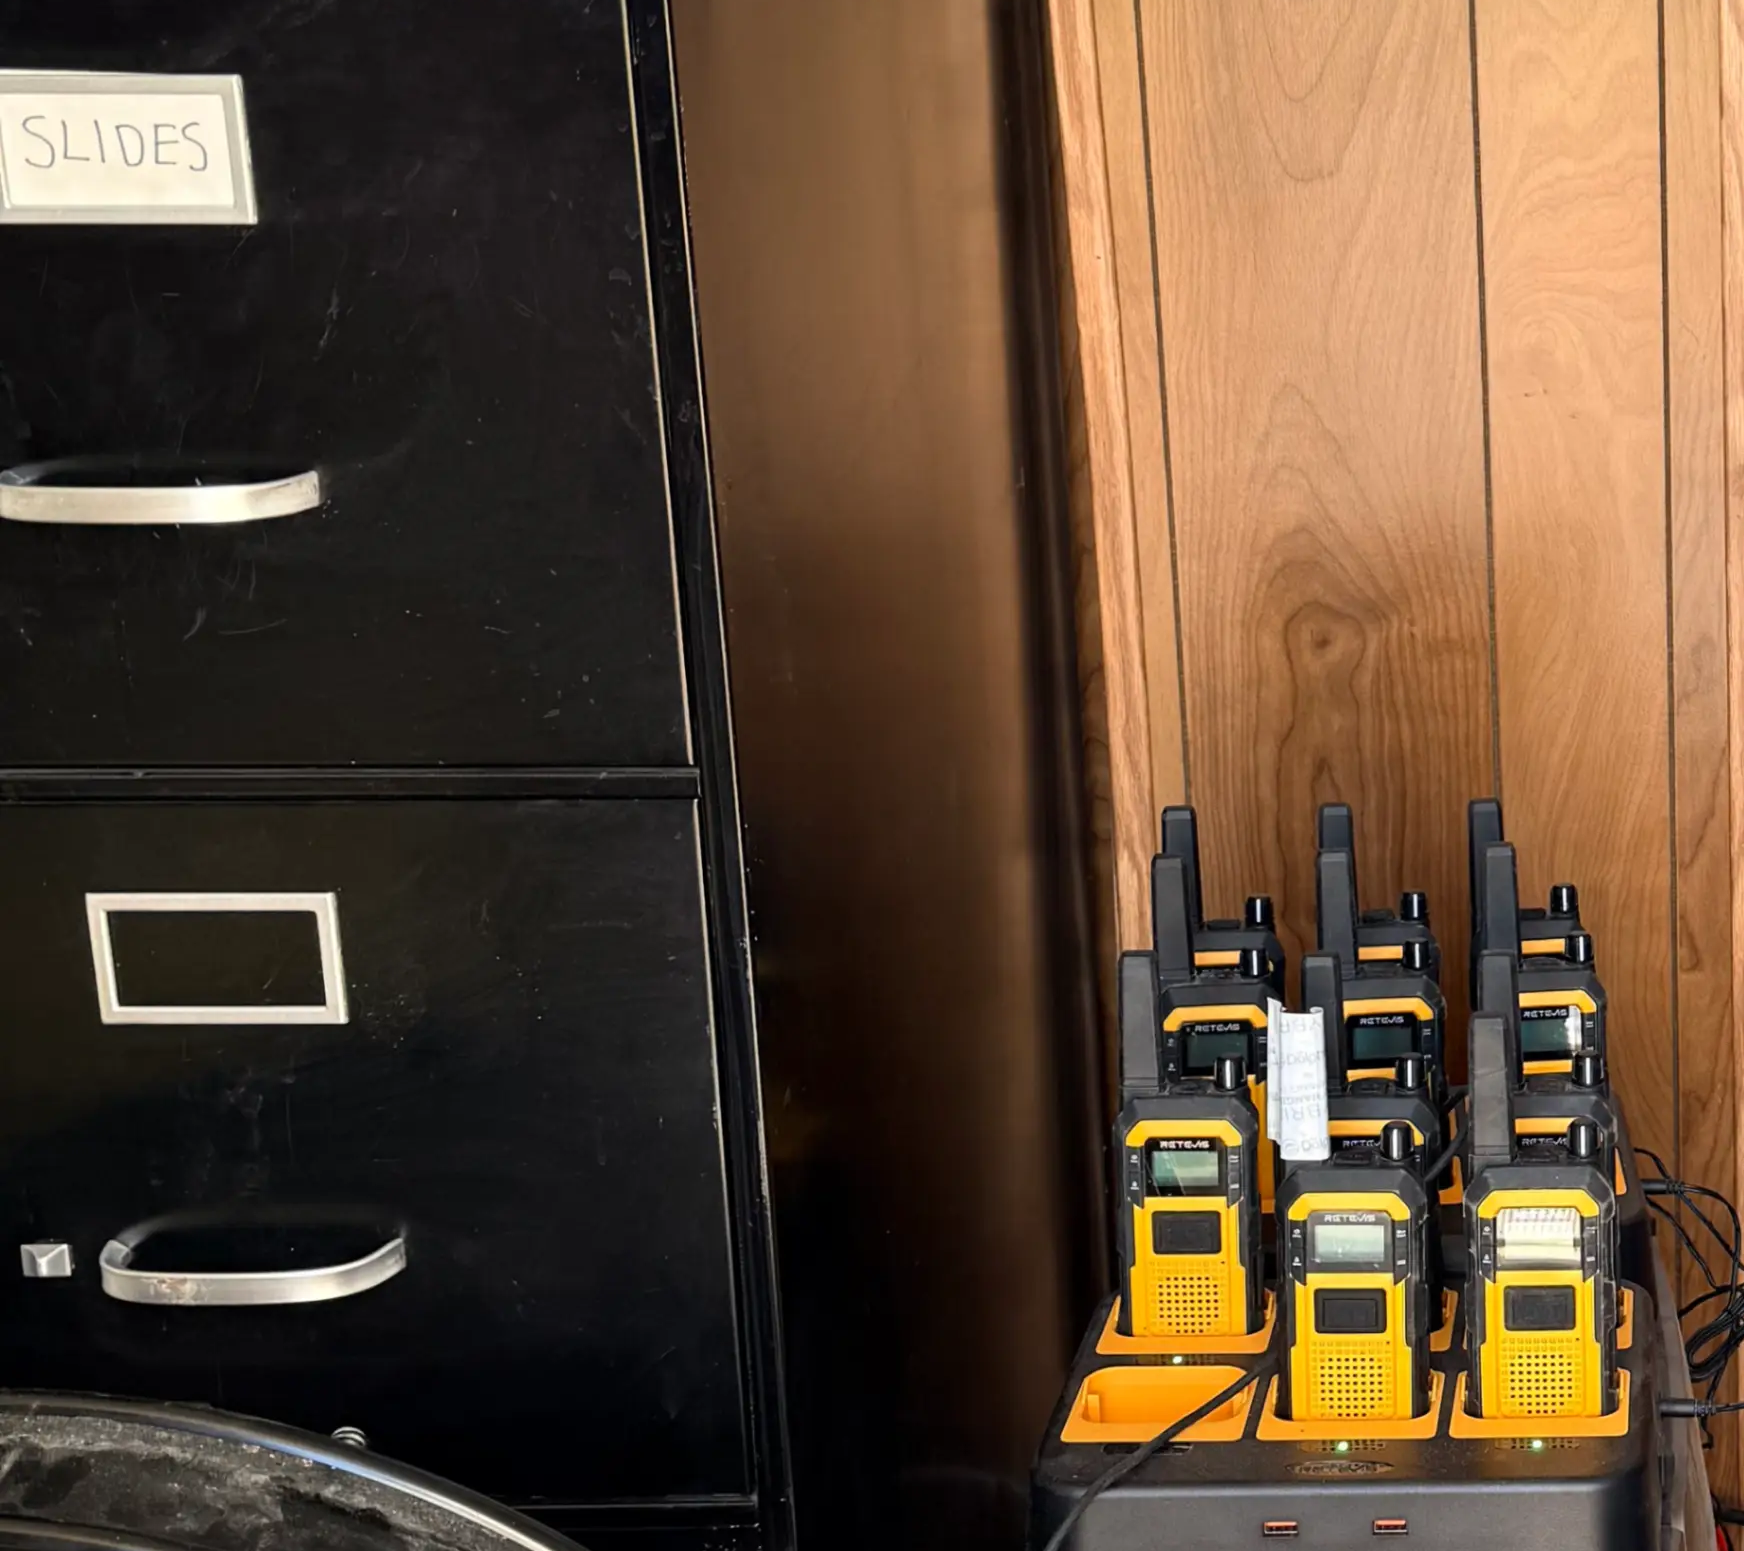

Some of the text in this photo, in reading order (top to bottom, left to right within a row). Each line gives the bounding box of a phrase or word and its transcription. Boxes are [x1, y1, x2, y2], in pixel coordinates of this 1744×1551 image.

[21, 114, 210, 173] SLIDES
[1160, 1140, 1210, 1150] RETEVIS
[1324, 1214, 1376, 1224] RETEVIS
